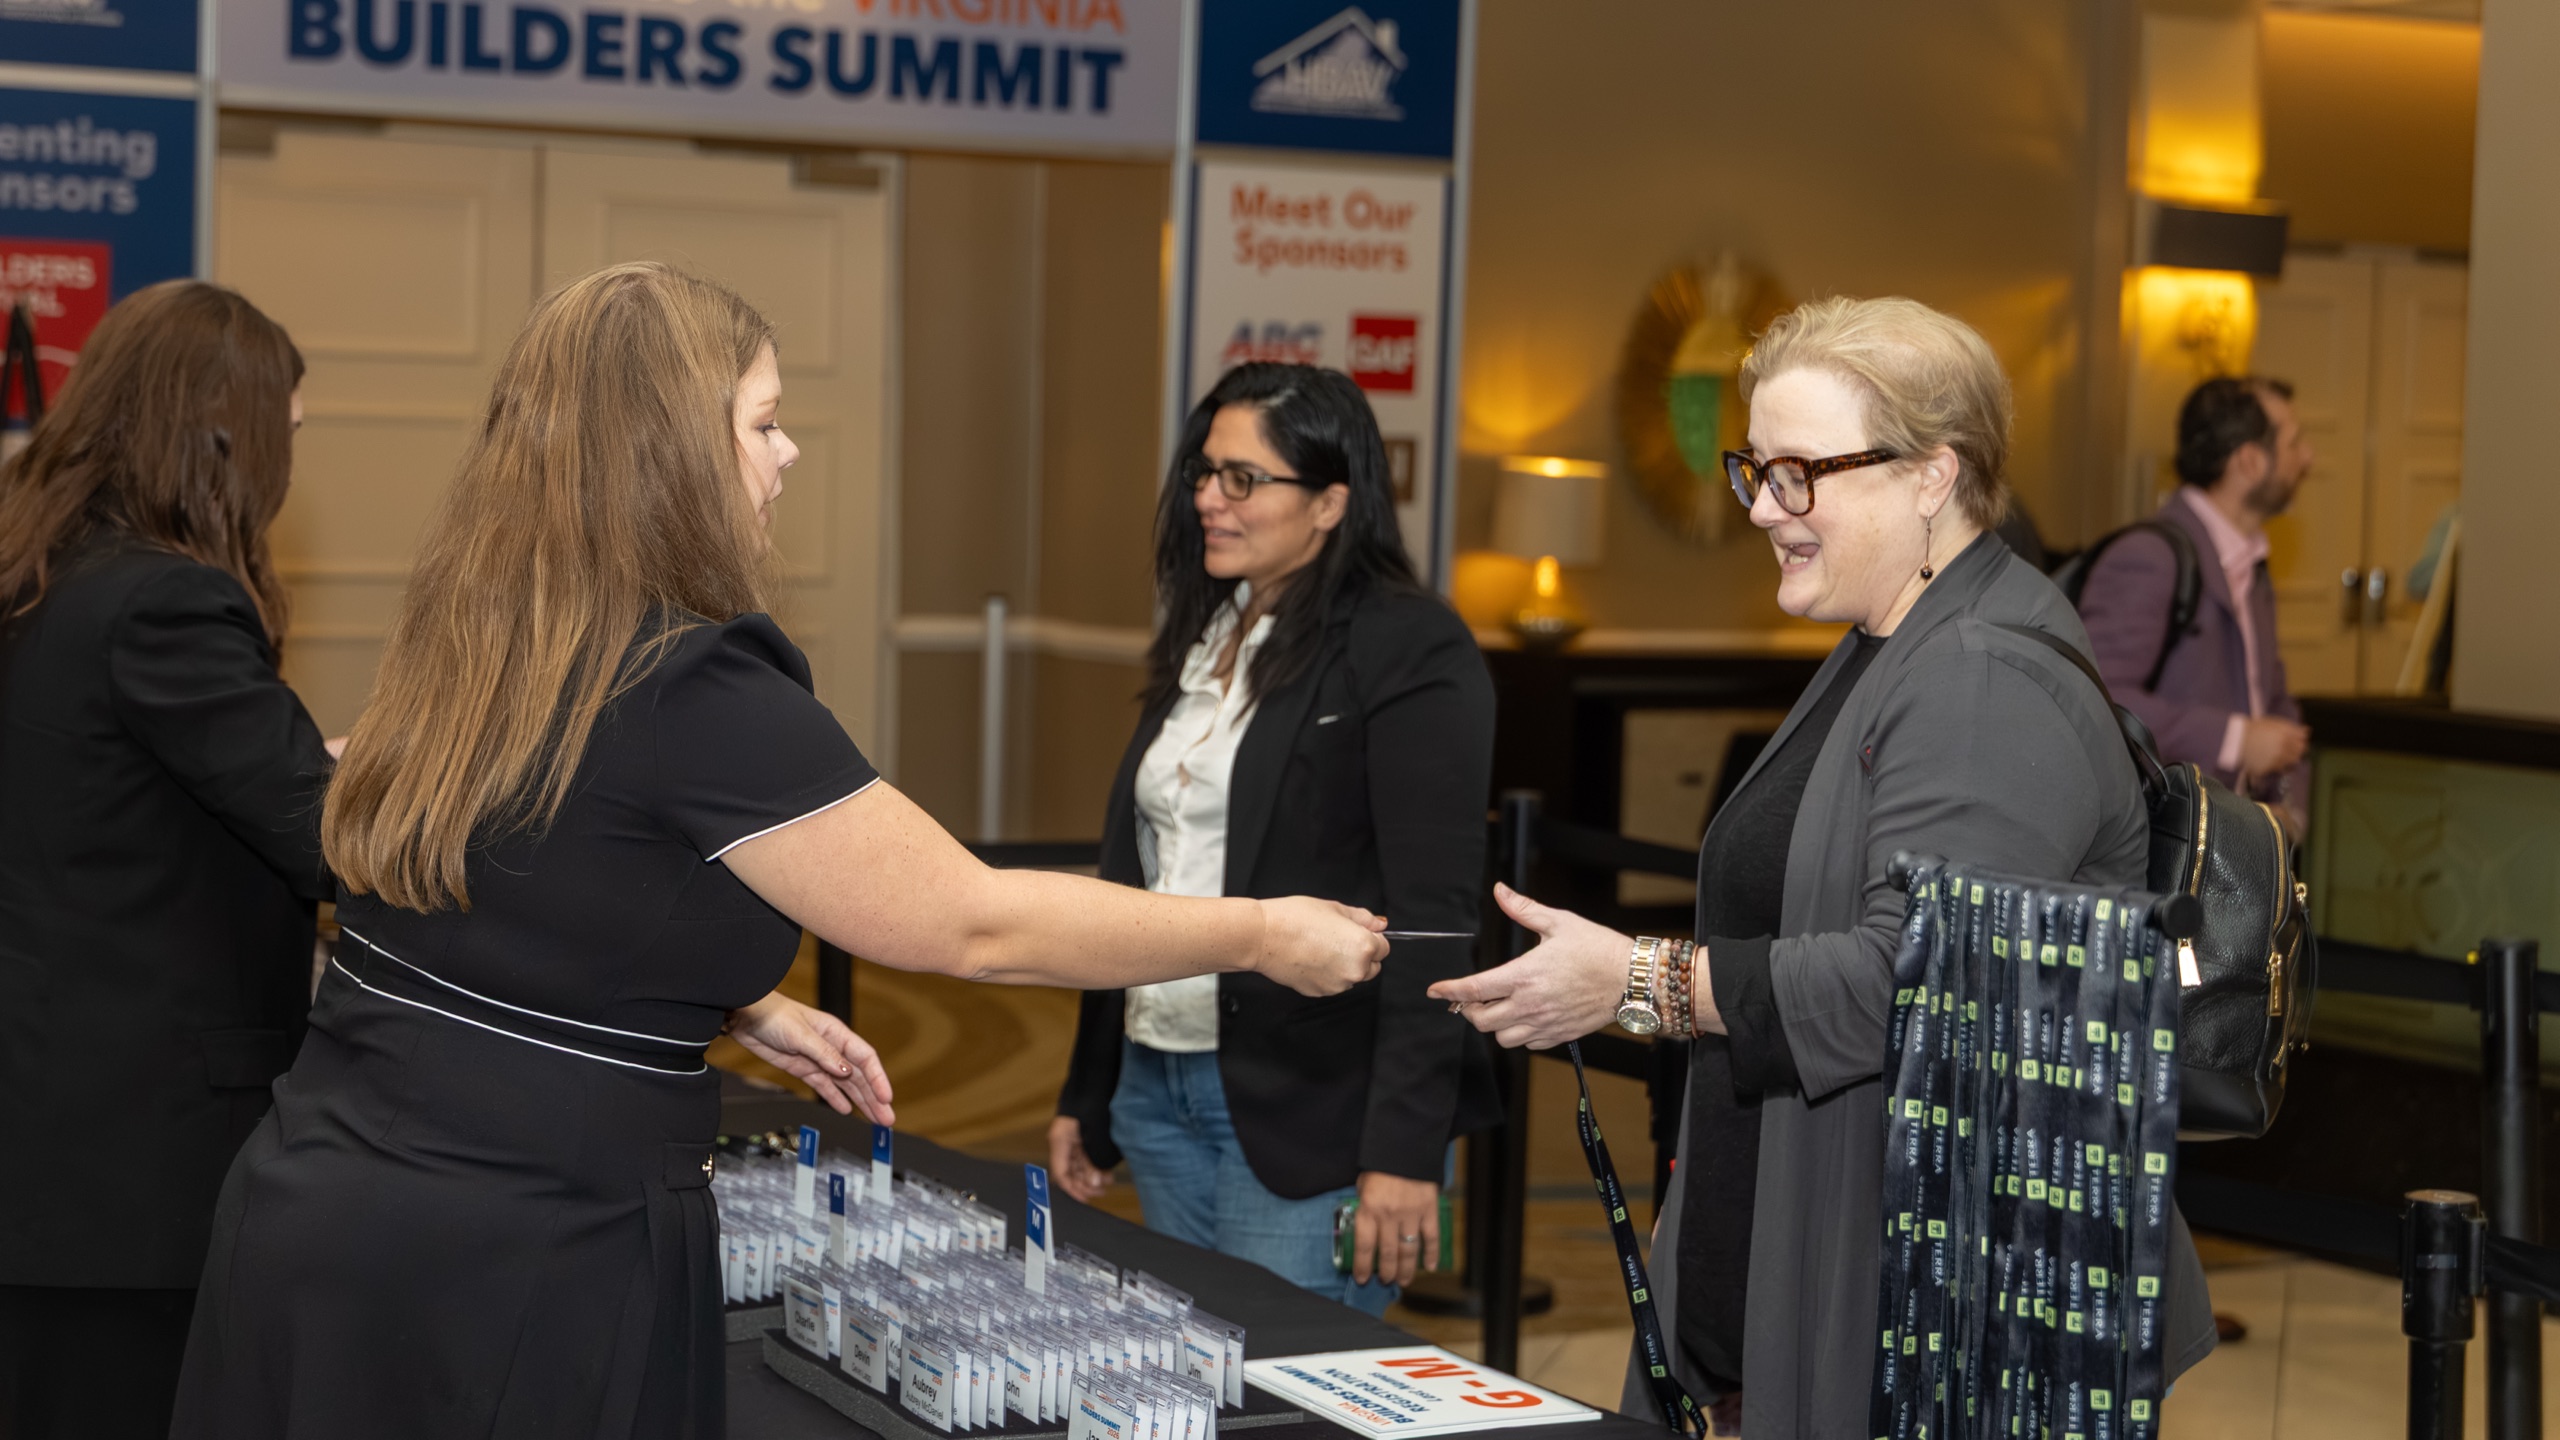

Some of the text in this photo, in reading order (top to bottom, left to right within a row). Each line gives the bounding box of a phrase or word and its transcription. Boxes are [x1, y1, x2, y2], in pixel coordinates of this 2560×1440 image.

[288, 0, 1123, 114] BUILDERS SUMMIT
[1231, 184, 1418, 231] Meet Our
[1235, 226, 1409, 276] Sponsors
[1914, 1006, 1925, 1053] TERRA
[2092, 1045, 2103, 1095] TERRA
[2156, 1054, 2170, 1104] TERRA
[878, 1130, 886, 1148] J
[1908, 1121, 1919, 1167] TERRA
[1935, 1128, 1945, 1174] TERRA
[2026, 1128, 2038, 1178] TERRA
[2051, 1136, 2064, 1184] TERRA
[1032, 1171, 1040, 1190] L
[2073, 1139, 2085, 1188] TERRA
[834, 1179, 841, 1198] K
[1607, 1173, 1618, 1207] TERRA
[2092, 1168, 2102, 1219] TERRA
[2149, 1176, 2162, 1227] TERRA
[1032, 1209, 1040, 1230] M
[1626, 1255, 1641, 1288] TERRA
[1934, 1242, 1945, 1287] TERRA
[2034, 1248, 2046, 1297] TERRA
[2070, 1260, 2081, 1310] TERRA
[2095, 1290, 2106, 1341] TERRA
[2140, 1300, 2153, 1350] TERRA
[854, 1344, 871, 1367] Devin
[1197, 1348, 1215, 1361] SUMMIT
[1202, 1357, 1214, 1369] 2026
[1646, 1333, 1658, 1365] TERRA
[911, 1373, 938, 1403] Aubrey
[1187, 1363, 1202, 1381] Jim
[1273, 1365, 1416, 1424] BUILDERS SUMMIT
[1321, 1368, 1430, 1413] REGISTRATION
[1883, 1352, 1895, 1395] TERRA
[905, 1390, 921, 1410] Aubrey
[1081, 1403, 1101, 1422] BUILDERS
[1100, 1414, 1121, 1432] SUMMIT
[1337, 1401, 1391, 1426] VIRGINIA
[2069, 1381, 2080, 1430] TERRA
[1106, 1427, 1120, 1439] 2026
